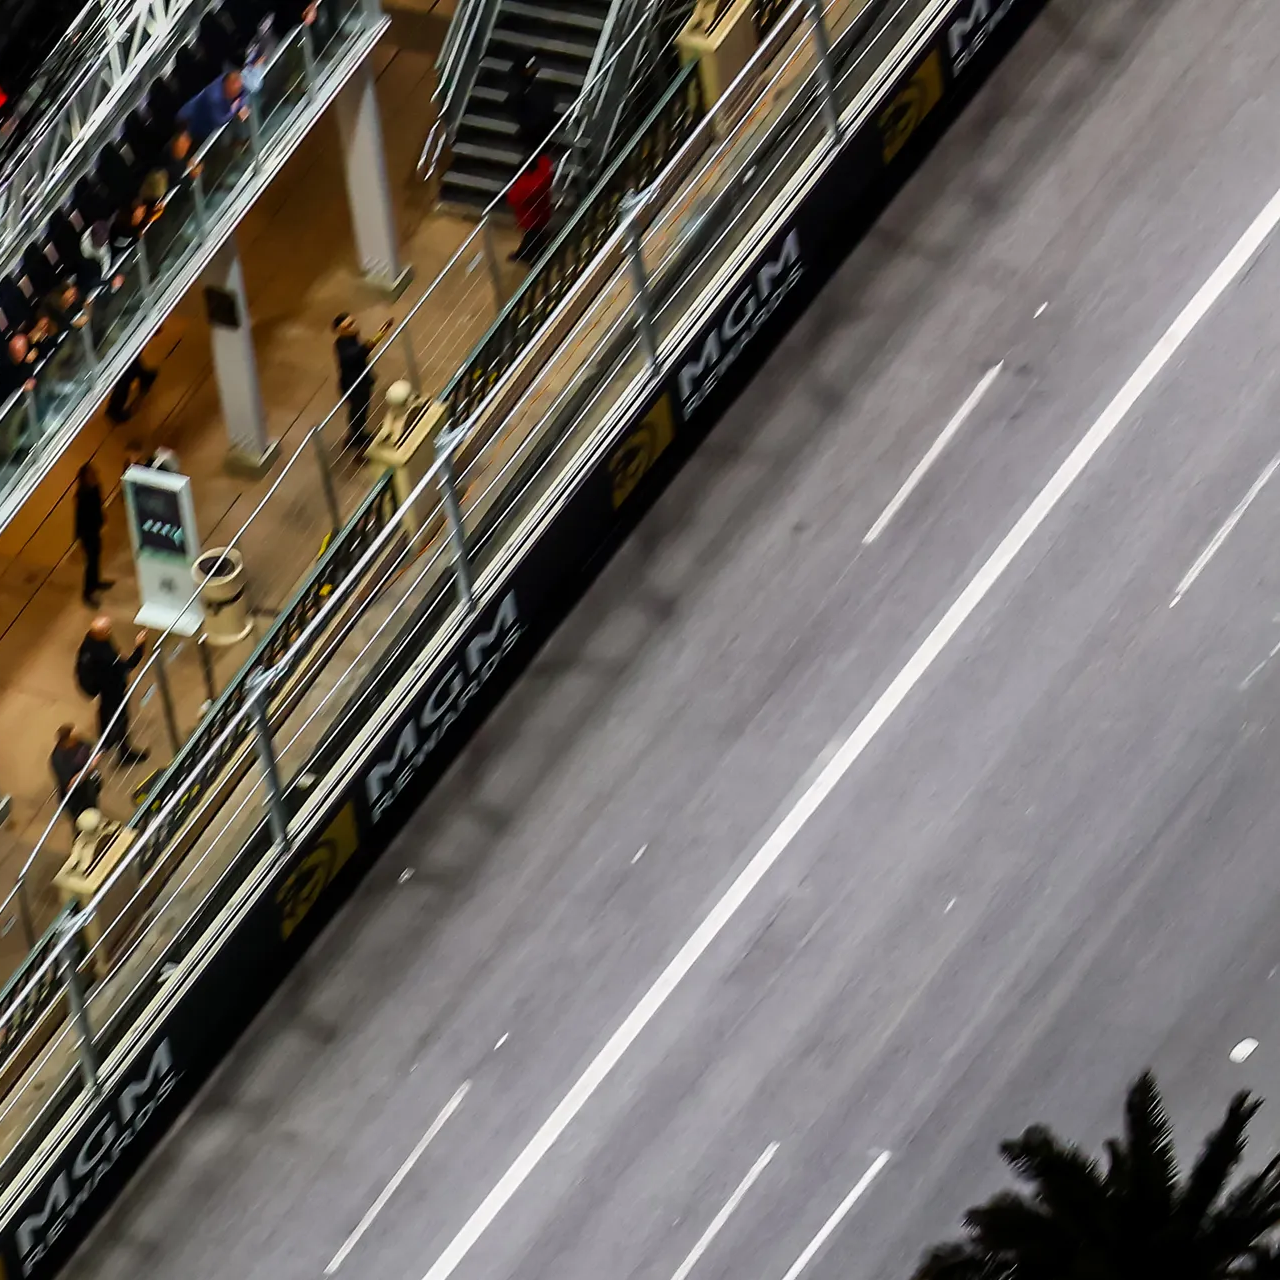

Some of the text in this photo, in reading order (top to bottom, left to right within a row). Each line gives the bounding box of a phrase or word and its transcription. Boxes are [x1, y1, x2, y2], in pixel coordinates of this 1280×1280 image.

[677, 227, 801, 404] MGM
[682, 255, 807, 422] REWARDS
[365, 588, 520, 803] MGM
[372, 617, 529, 824] REWARDS
[15, 1036, 174, 1266] MGM
[22, 1068, 185, 1280] REWARDS
